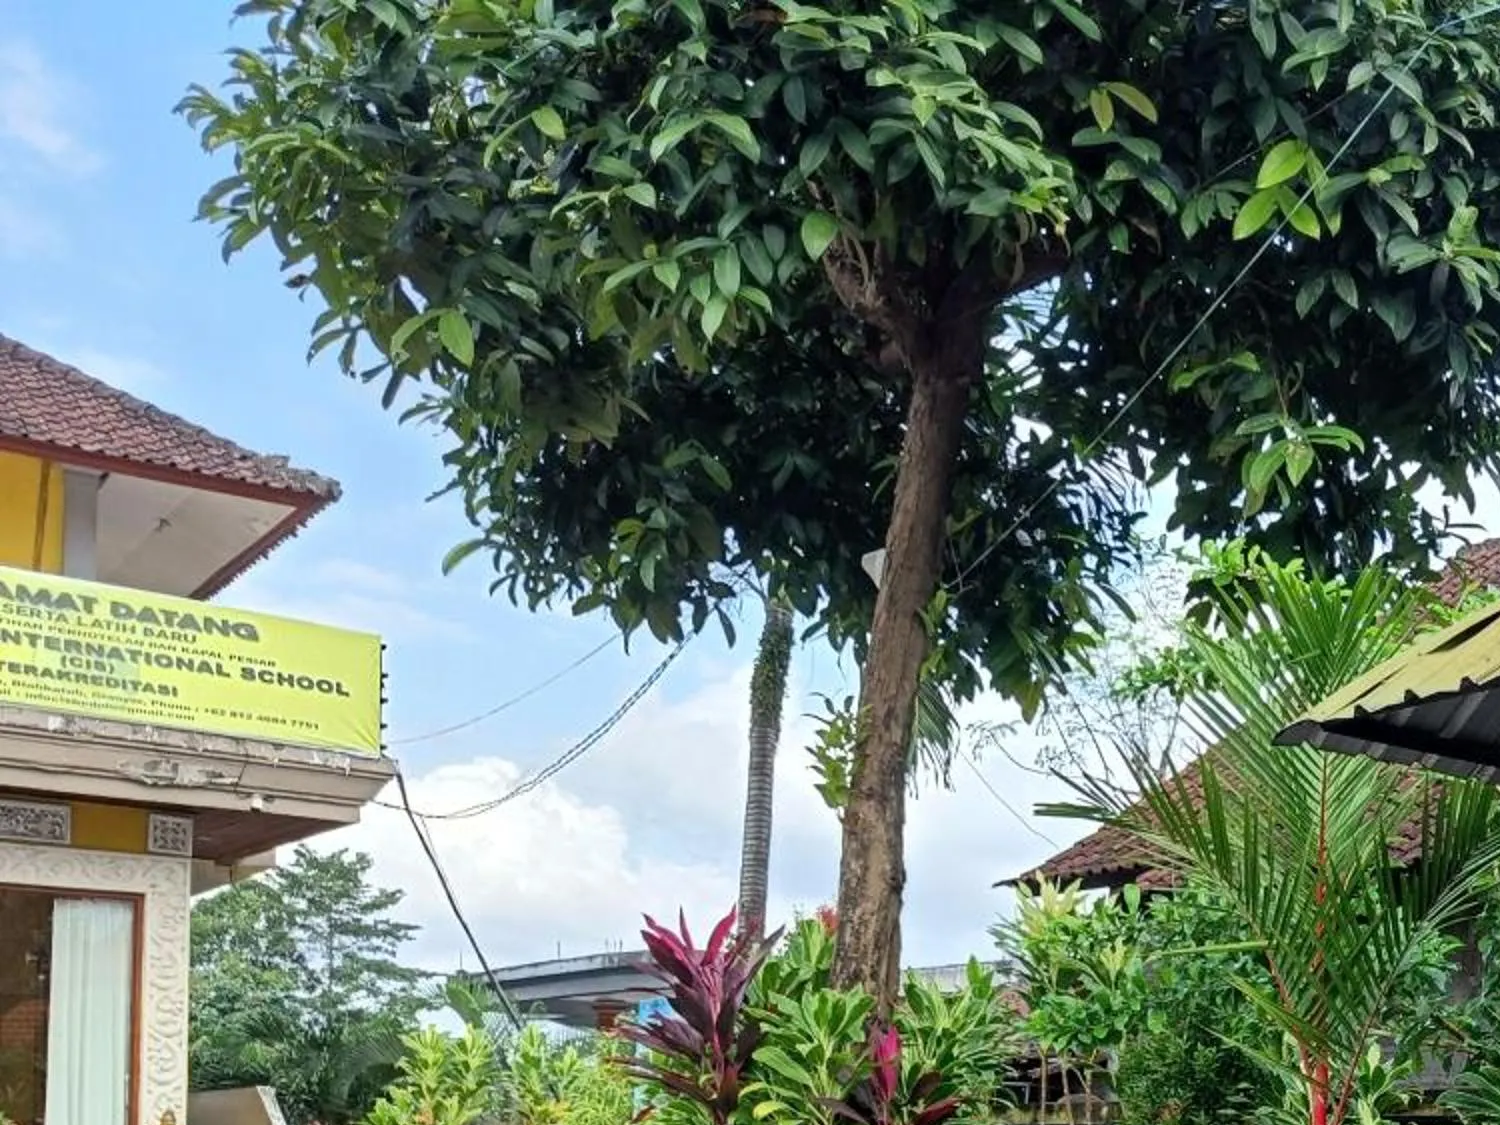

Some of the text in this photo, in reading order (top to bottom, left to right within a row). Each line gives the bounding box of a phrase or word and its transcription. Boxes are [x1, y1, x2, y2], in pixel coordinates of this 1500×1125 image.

[77, 615, 137, 635] LATIH
[143, 627, 197, 644] BARU
[110, 601, 260, 643] DATANG
[240, 666, 351, 698] SCHOOL
